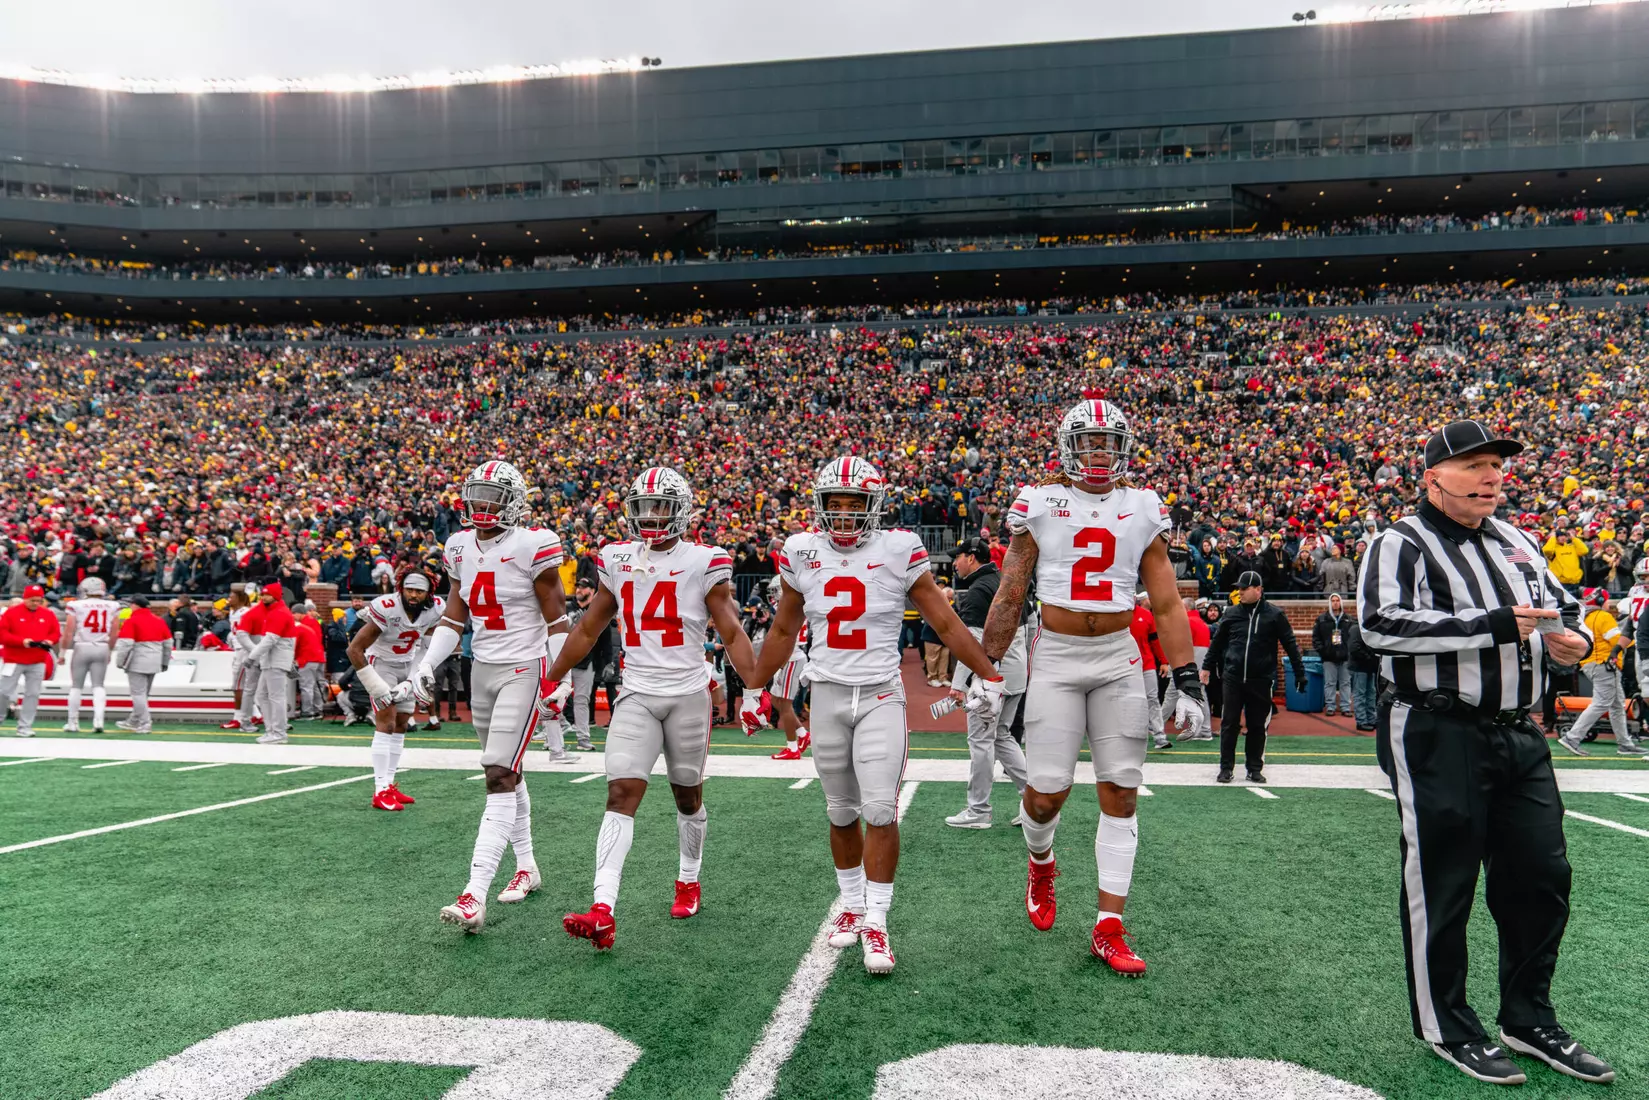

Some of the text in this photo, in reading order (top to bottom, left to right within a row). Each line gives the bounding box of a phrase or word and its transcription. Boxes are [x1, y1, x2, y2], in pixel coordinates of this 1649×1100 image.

[1070, 527, 1116, 601] 2
[1206, 563, 1214, 579] 7
[468, 571, 507, 631] 4
[1527, 580, 1540, 600] F
[83, 609, 107, 633] 41
[620, 580, 684, 647] 14
[823, 576, 867, 650] 2
[1631, 597, 1649, 622] 7
[392, 629, 420, 655] 3
